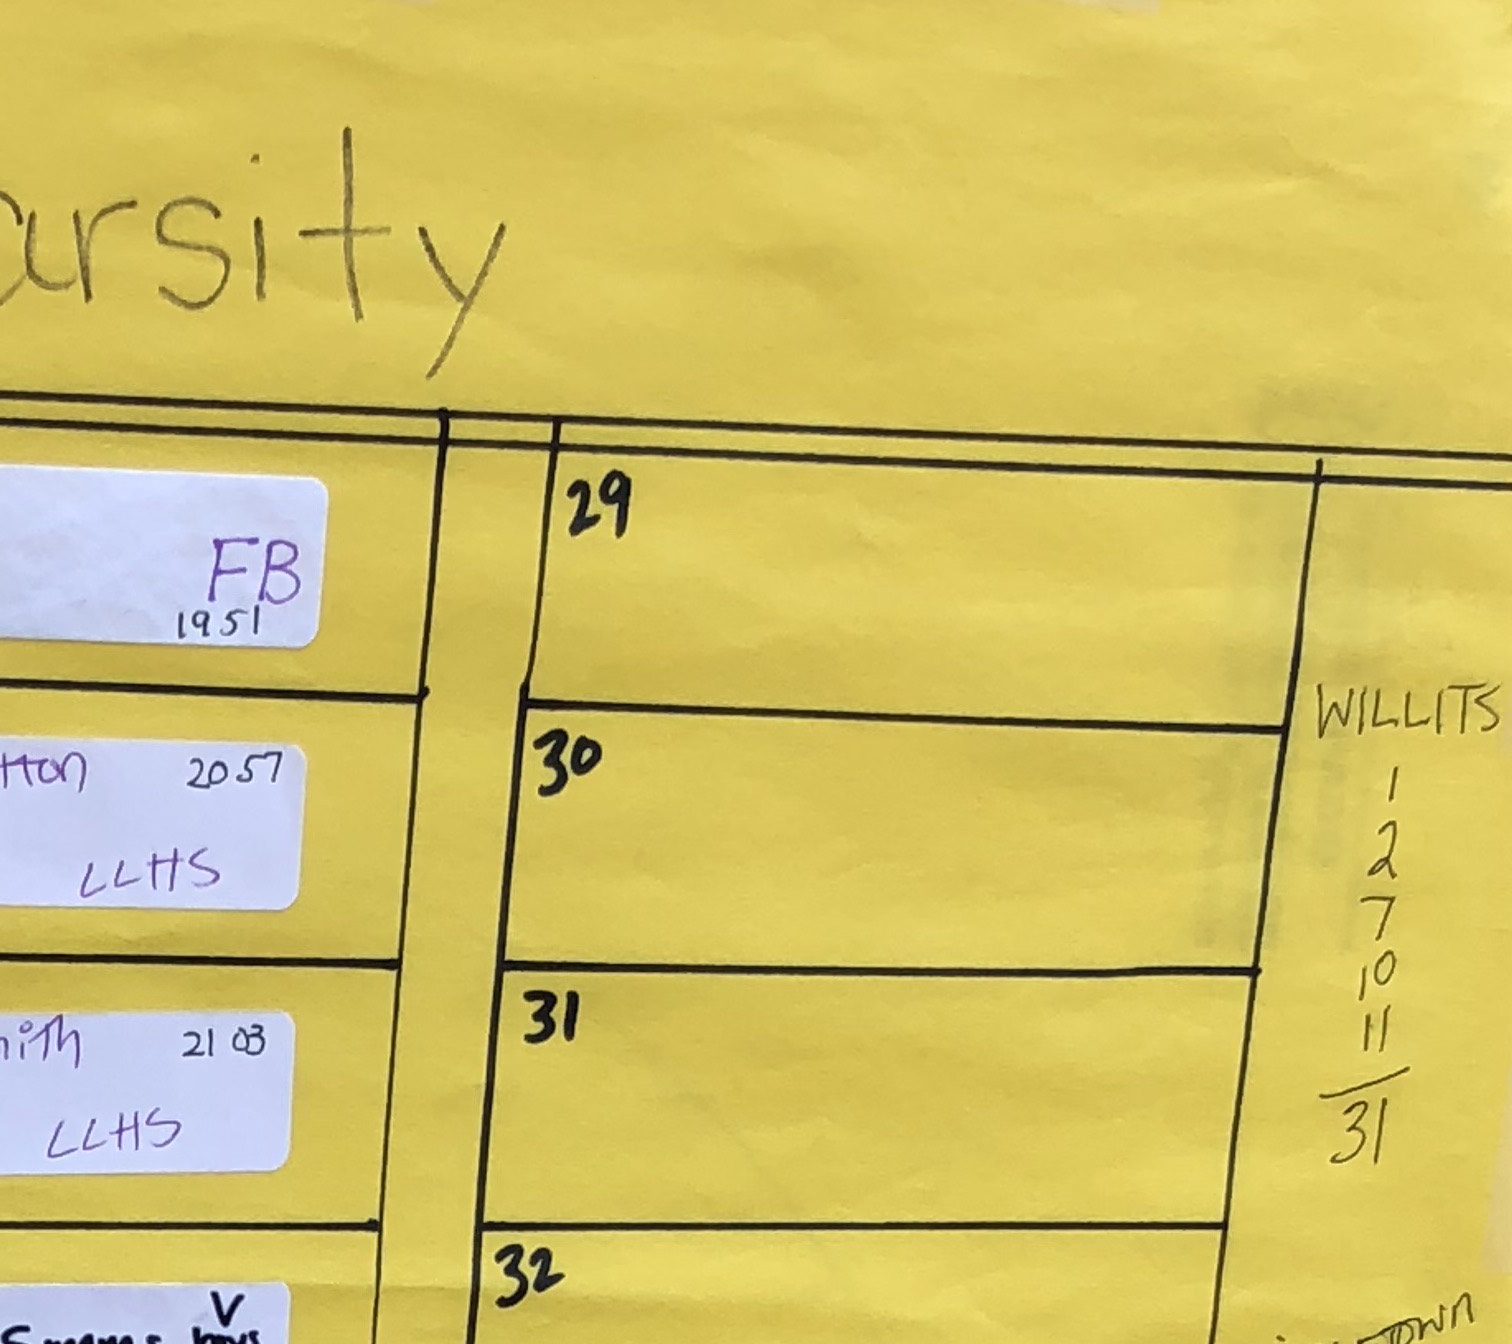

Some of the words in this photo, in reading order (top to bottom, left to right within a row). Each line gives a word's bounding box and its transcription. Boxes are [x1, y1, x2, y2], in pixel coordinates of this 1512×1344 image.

[566, 468, 632, 539] 29
[208, 536, 301, 605] FB
[1316, 680, 1503, 739] WILLITS
[532, 724, 603, 798] 30
[1388, 766, 1399, 803] 1
[1367, 820, 1398, 885] 2
[1360, 888, 1397, 941] 7
[1358, 949, 1397, 1001] 10
[522, 989, 580, 1045] 31
[1363, 1004, 1391, 1053] 11
[1329, 1096, 1388, 1165] 31
[494, 1243, 566, 1309] 32
